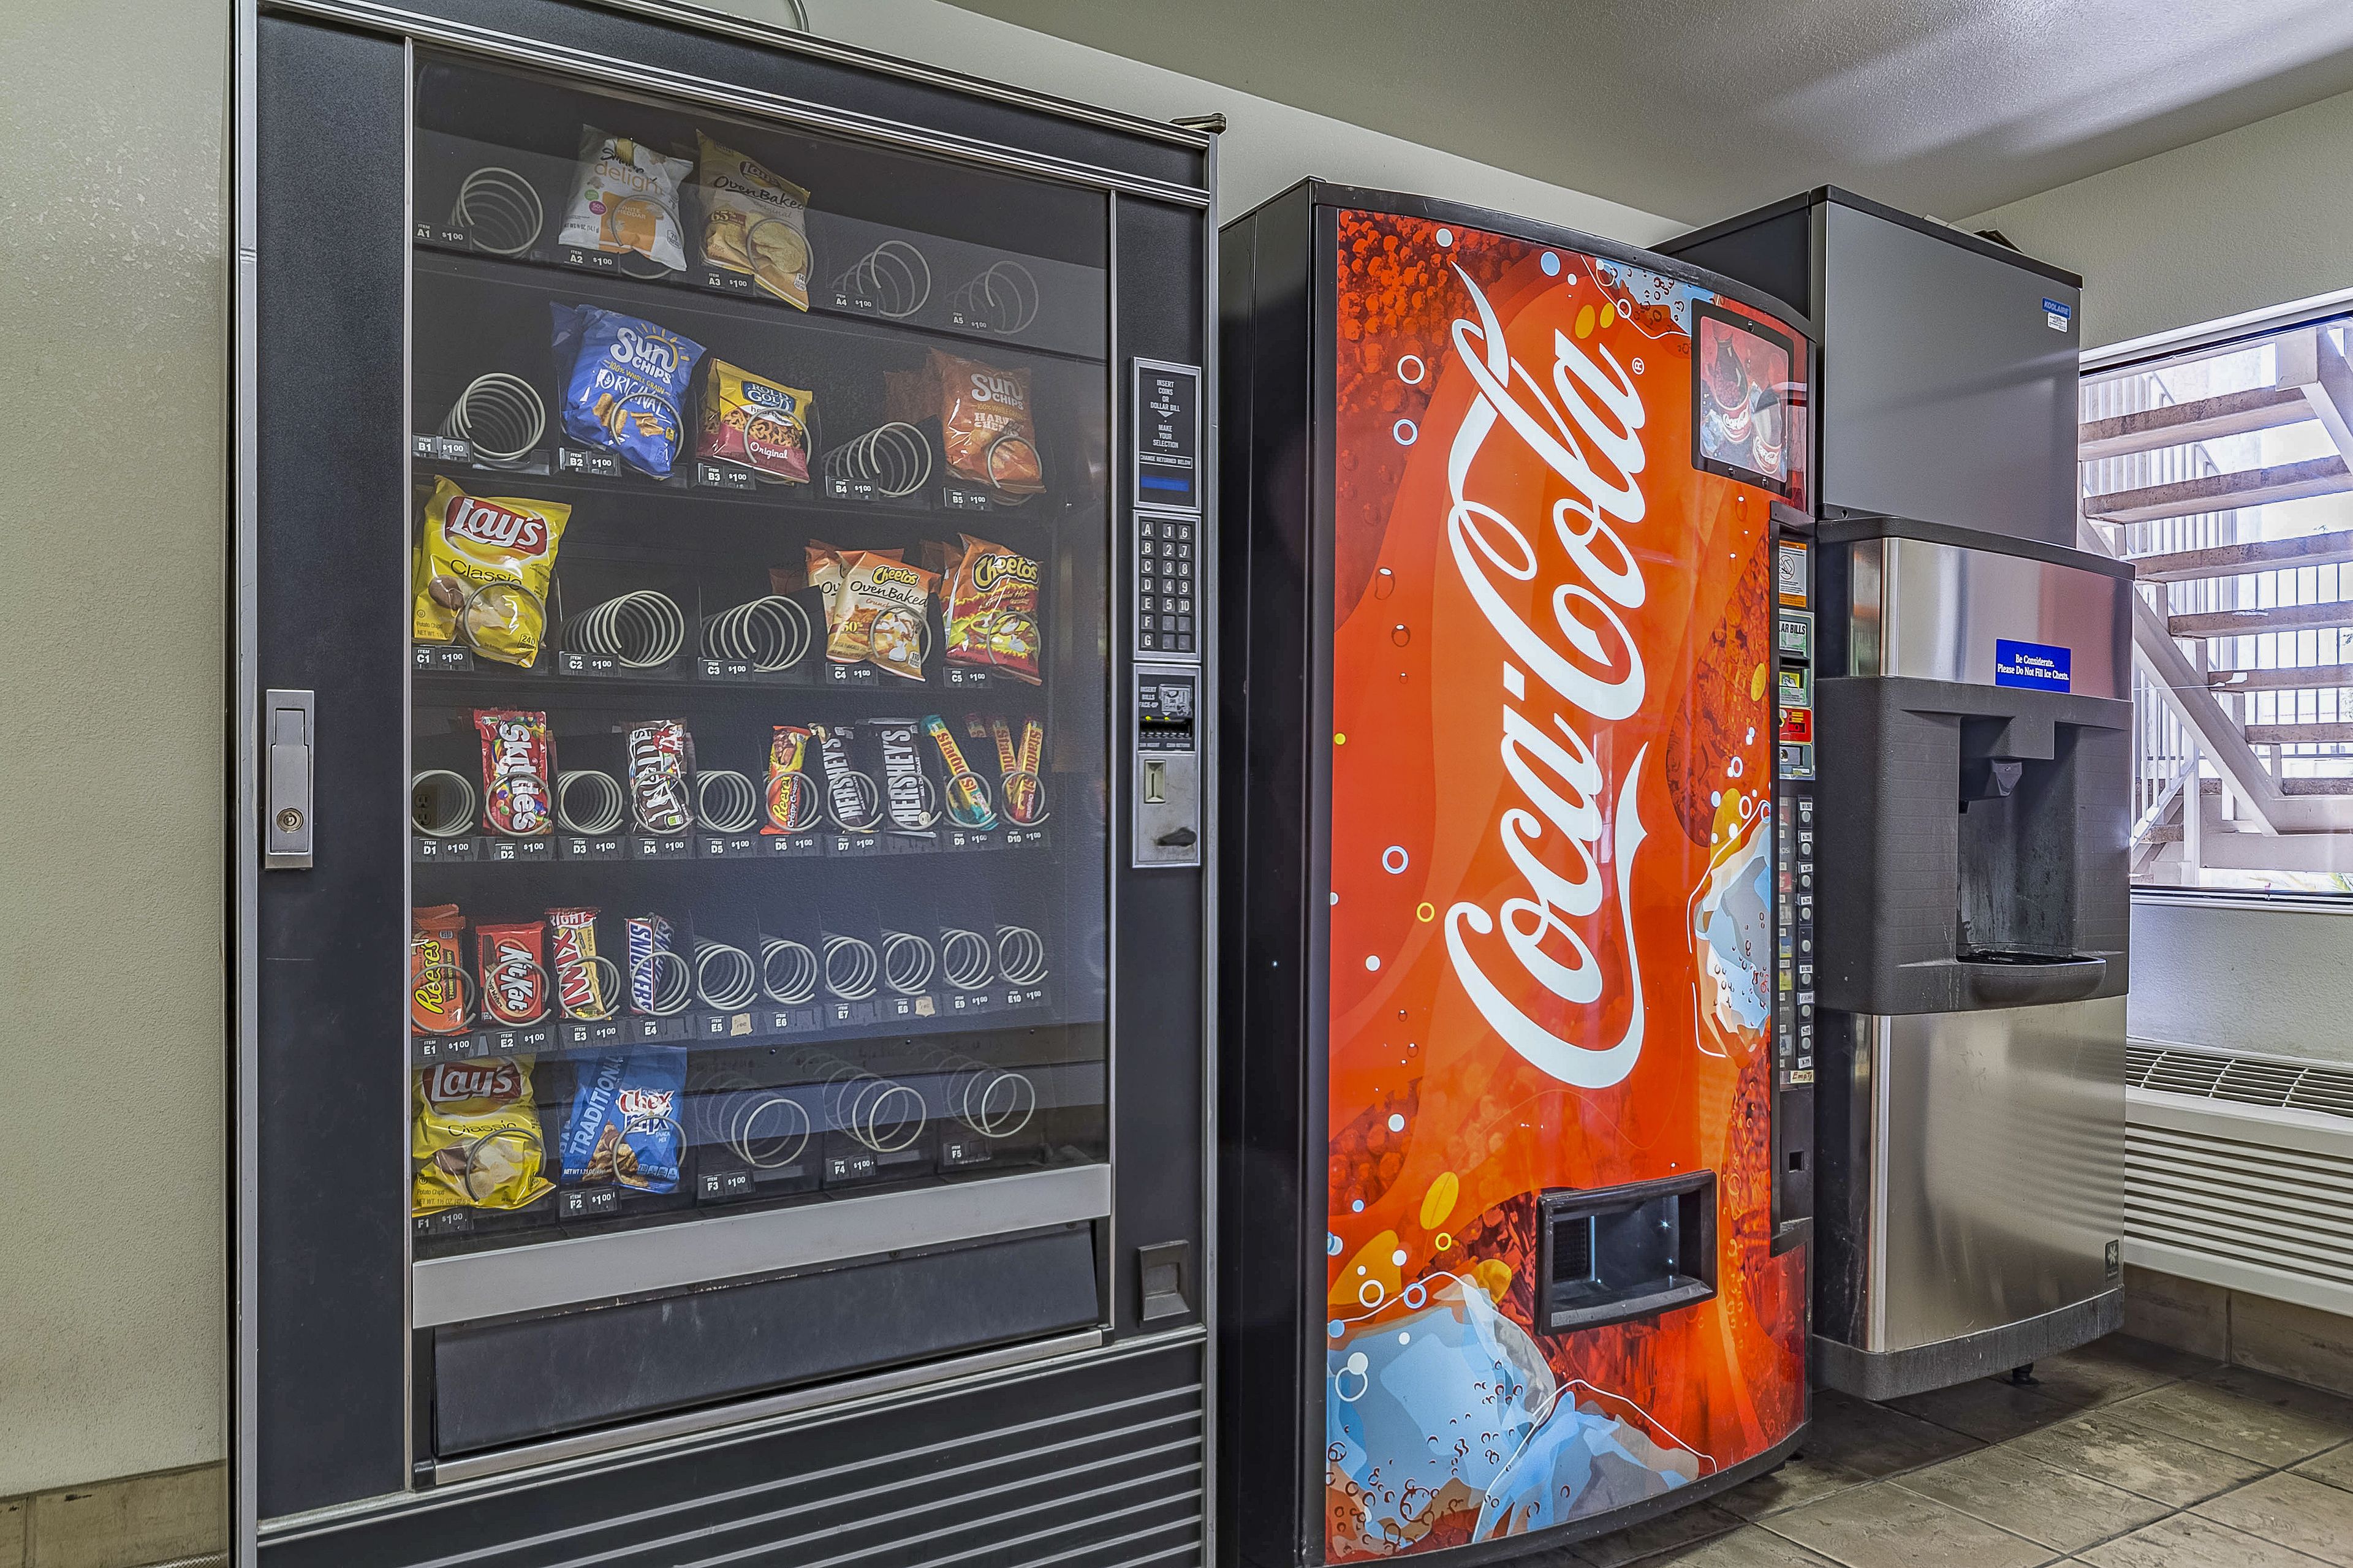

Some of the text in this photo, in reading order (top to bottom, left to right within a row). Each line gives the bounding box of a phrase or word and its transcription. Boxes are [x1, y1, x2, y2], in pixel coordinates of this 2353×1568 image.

[610, 327, 675, 373] Sun
[632, 356, 672, 384] CHIPS
[750, 384, 789, 400] ROLD
[970, 373, 1023, 402] Sun
[748, 390, 790, 411] GOLD
[991, 393, 1025, 411] CHIPS
[1150, 402, 1169, 411] DOLLAR
[419, 442, 431, 451] B1
[750, 441, 789, 460] Original
[1153, 439, 1179, 449] SELECTION
[570, 458, 583, 466] B2
[449, 498, 544, 547] Lay's
[1145, 524, 1188, 538] A 1 6
[1145, 542, 1188, 556] B 2 7
[974, 556, 1038, 587] Cheetos
[1145, 561, 1188, 574] C 3 8
[450, 559, 522, 591] Classic
[873, 567, 919, 585] Cheetos
[1145, 580, 1188, 593] D 4 9
[1145, 598, 1189, 611] E 5 10
[1145, 616, 1150, 627] F
[1790, 624, 1806, 635] BILLS
[1145, 635, 1151, 646] G
[2015, 654, 2055, 667] Be Considerate.
[1445, 260, 1647, 1089] Coca-Cola
[1997, 663, 2015, 674] Please
[2016, 665, 2023, 675] Do
[2025, 667, 2034, 676] Not
[2035, 668, 2044, 678] Fill
[415, 940, 444, 1014] Reese's
[645, 1026, 656, 1035] E4
[501, 1039, 513, 1047] E2
[424, 1045, 435, 1055] E1
[431, 1061, 515, 1102] Lay's
[619, 1089, 673, 1113] Chex
[835, 1165, 845, 1174] F4
[708, 1182, 718, 1191] F3
[570, 1200, 582, 1209] F2
[419, 1219, 428, 1228] F1
